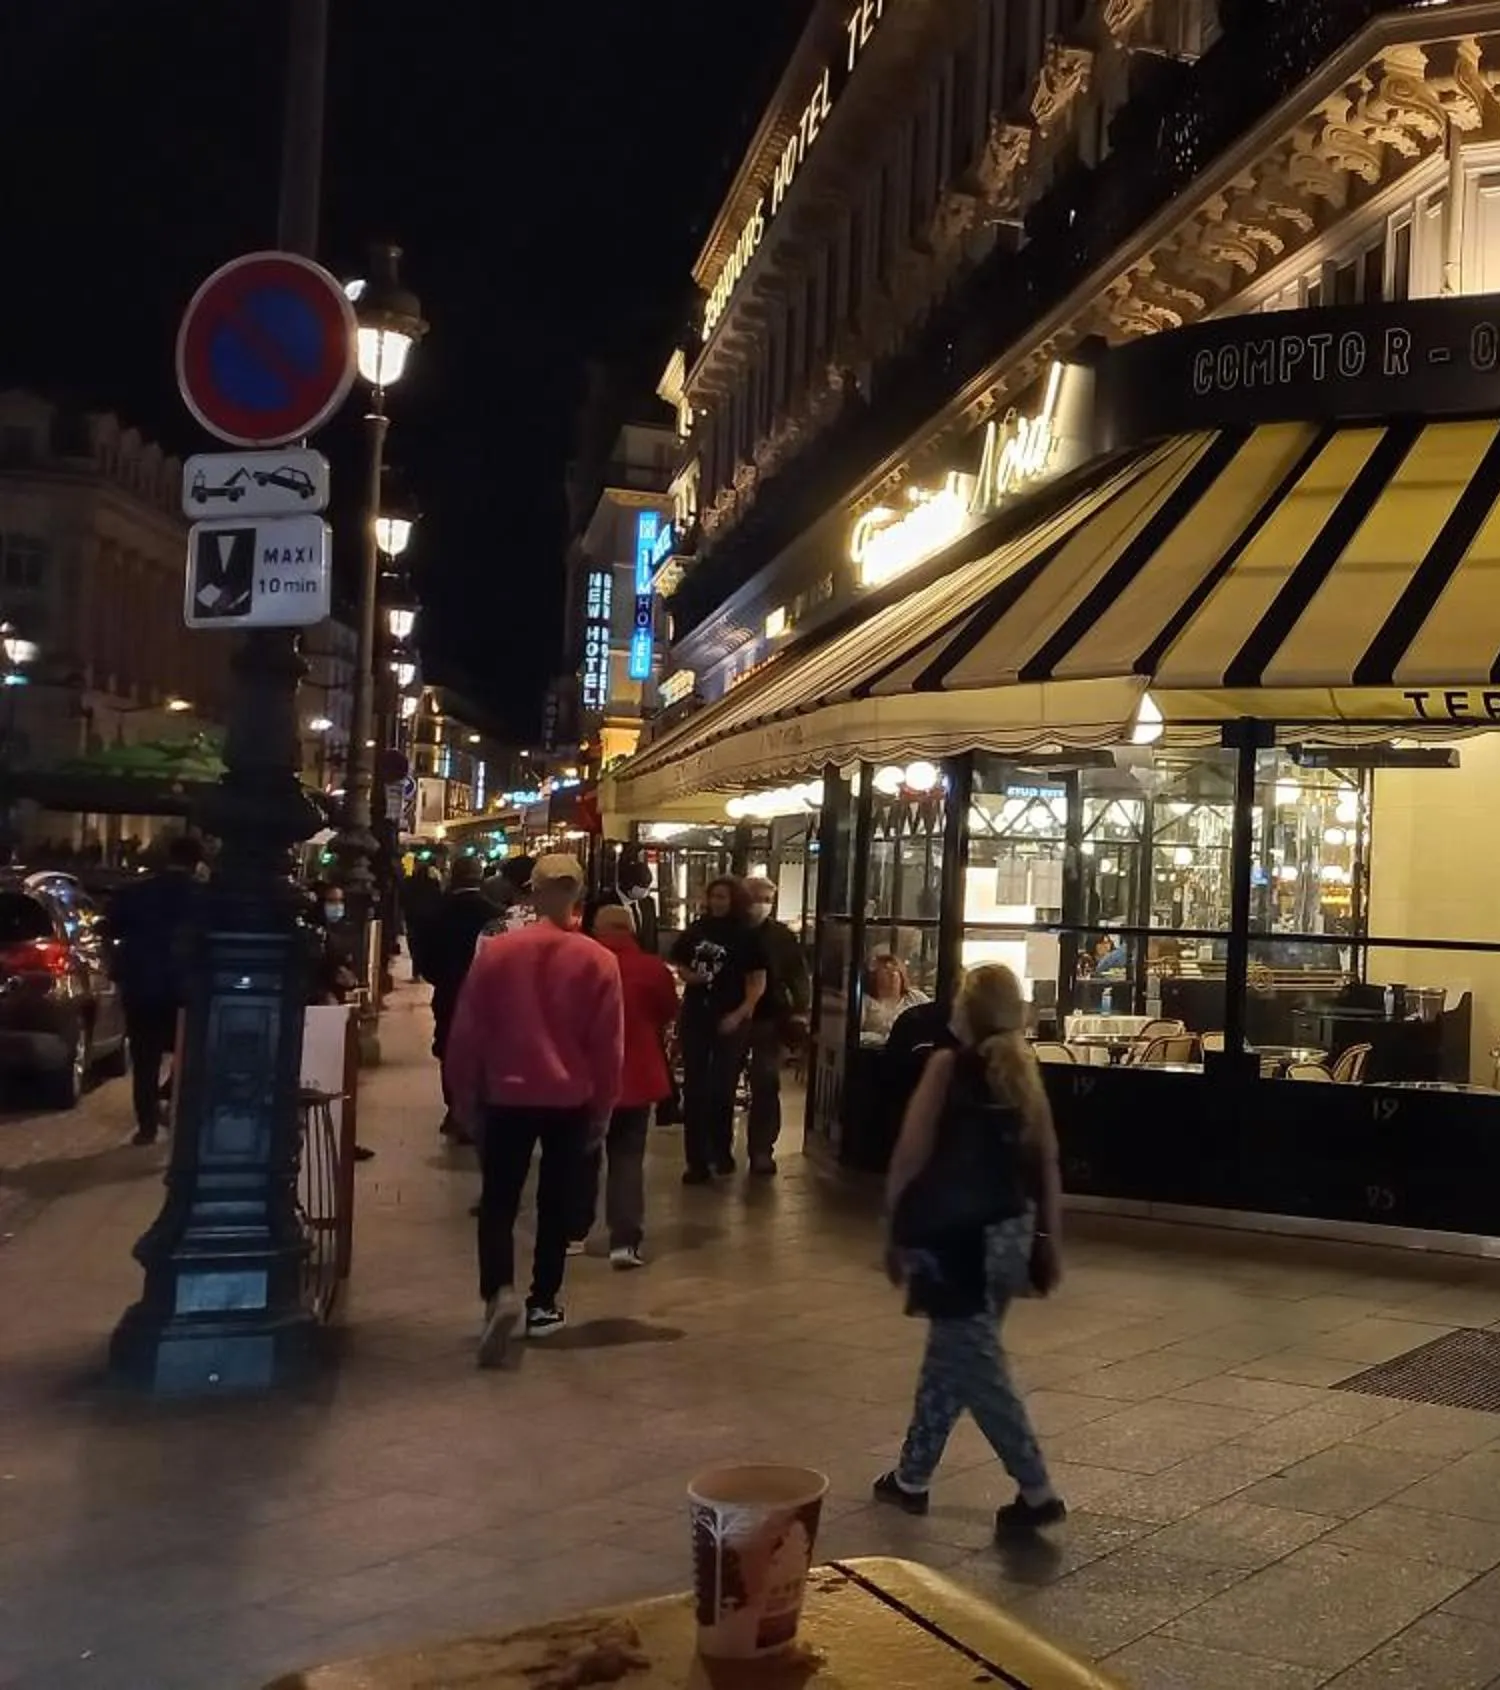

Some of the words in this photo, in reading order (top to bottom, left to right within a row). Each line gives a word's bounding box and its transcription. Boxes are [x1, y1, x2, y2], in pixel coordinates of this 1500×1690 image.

[769, 67, 832, 215] HOTEL
[847, 0, 883, 71] TE
[263, 547, 313, 565] MAXI
[587, 572, 600, 619] NEW
[583, 626, 600, 705] HOTEL
[1373, 1098, 1399, 1120] 19
